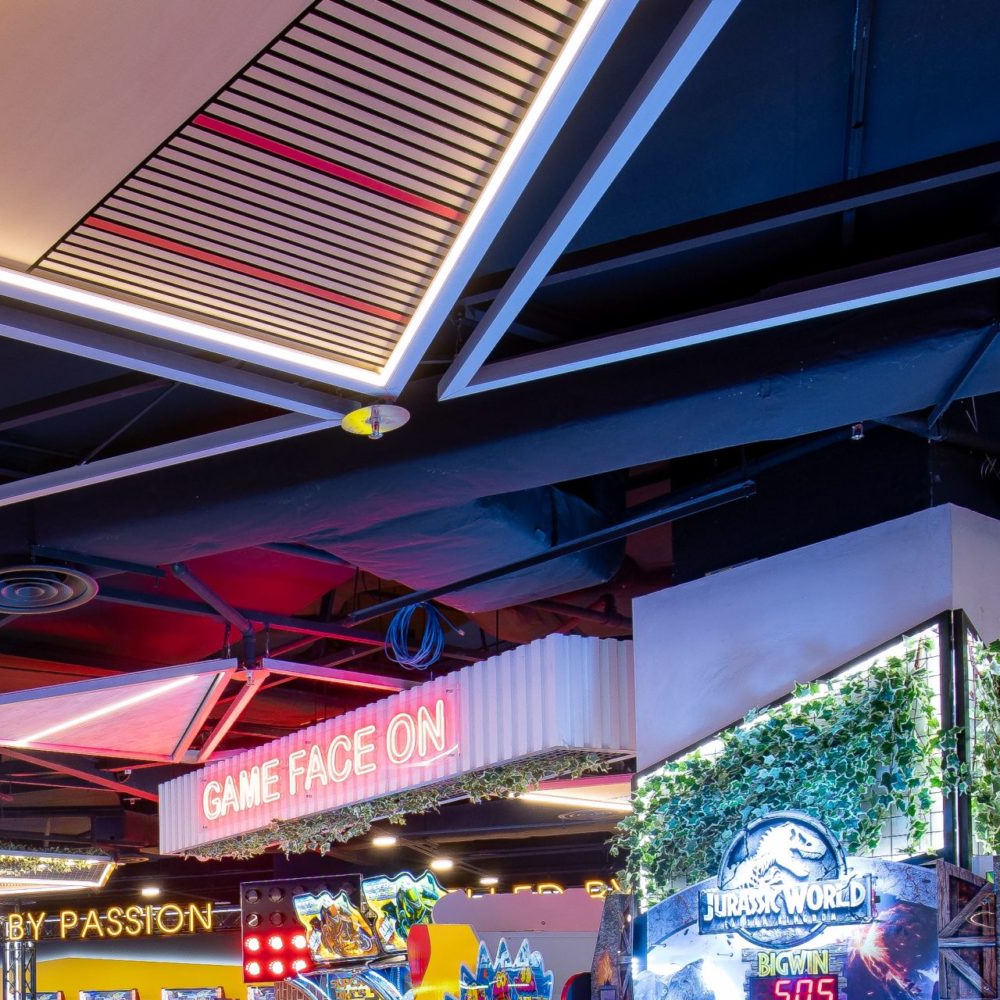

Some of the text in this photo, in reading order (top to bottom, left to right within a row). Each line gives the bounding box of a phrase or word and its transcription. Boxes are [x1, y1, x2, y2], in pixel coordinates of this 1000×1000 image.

[203, 699, 445, 820] GAME FACE ON
[704, 881, 866, 921] JURASSIC WORLD
[8, 912, 47, 941] BY
[61, 903, 213, 939] PASSION
